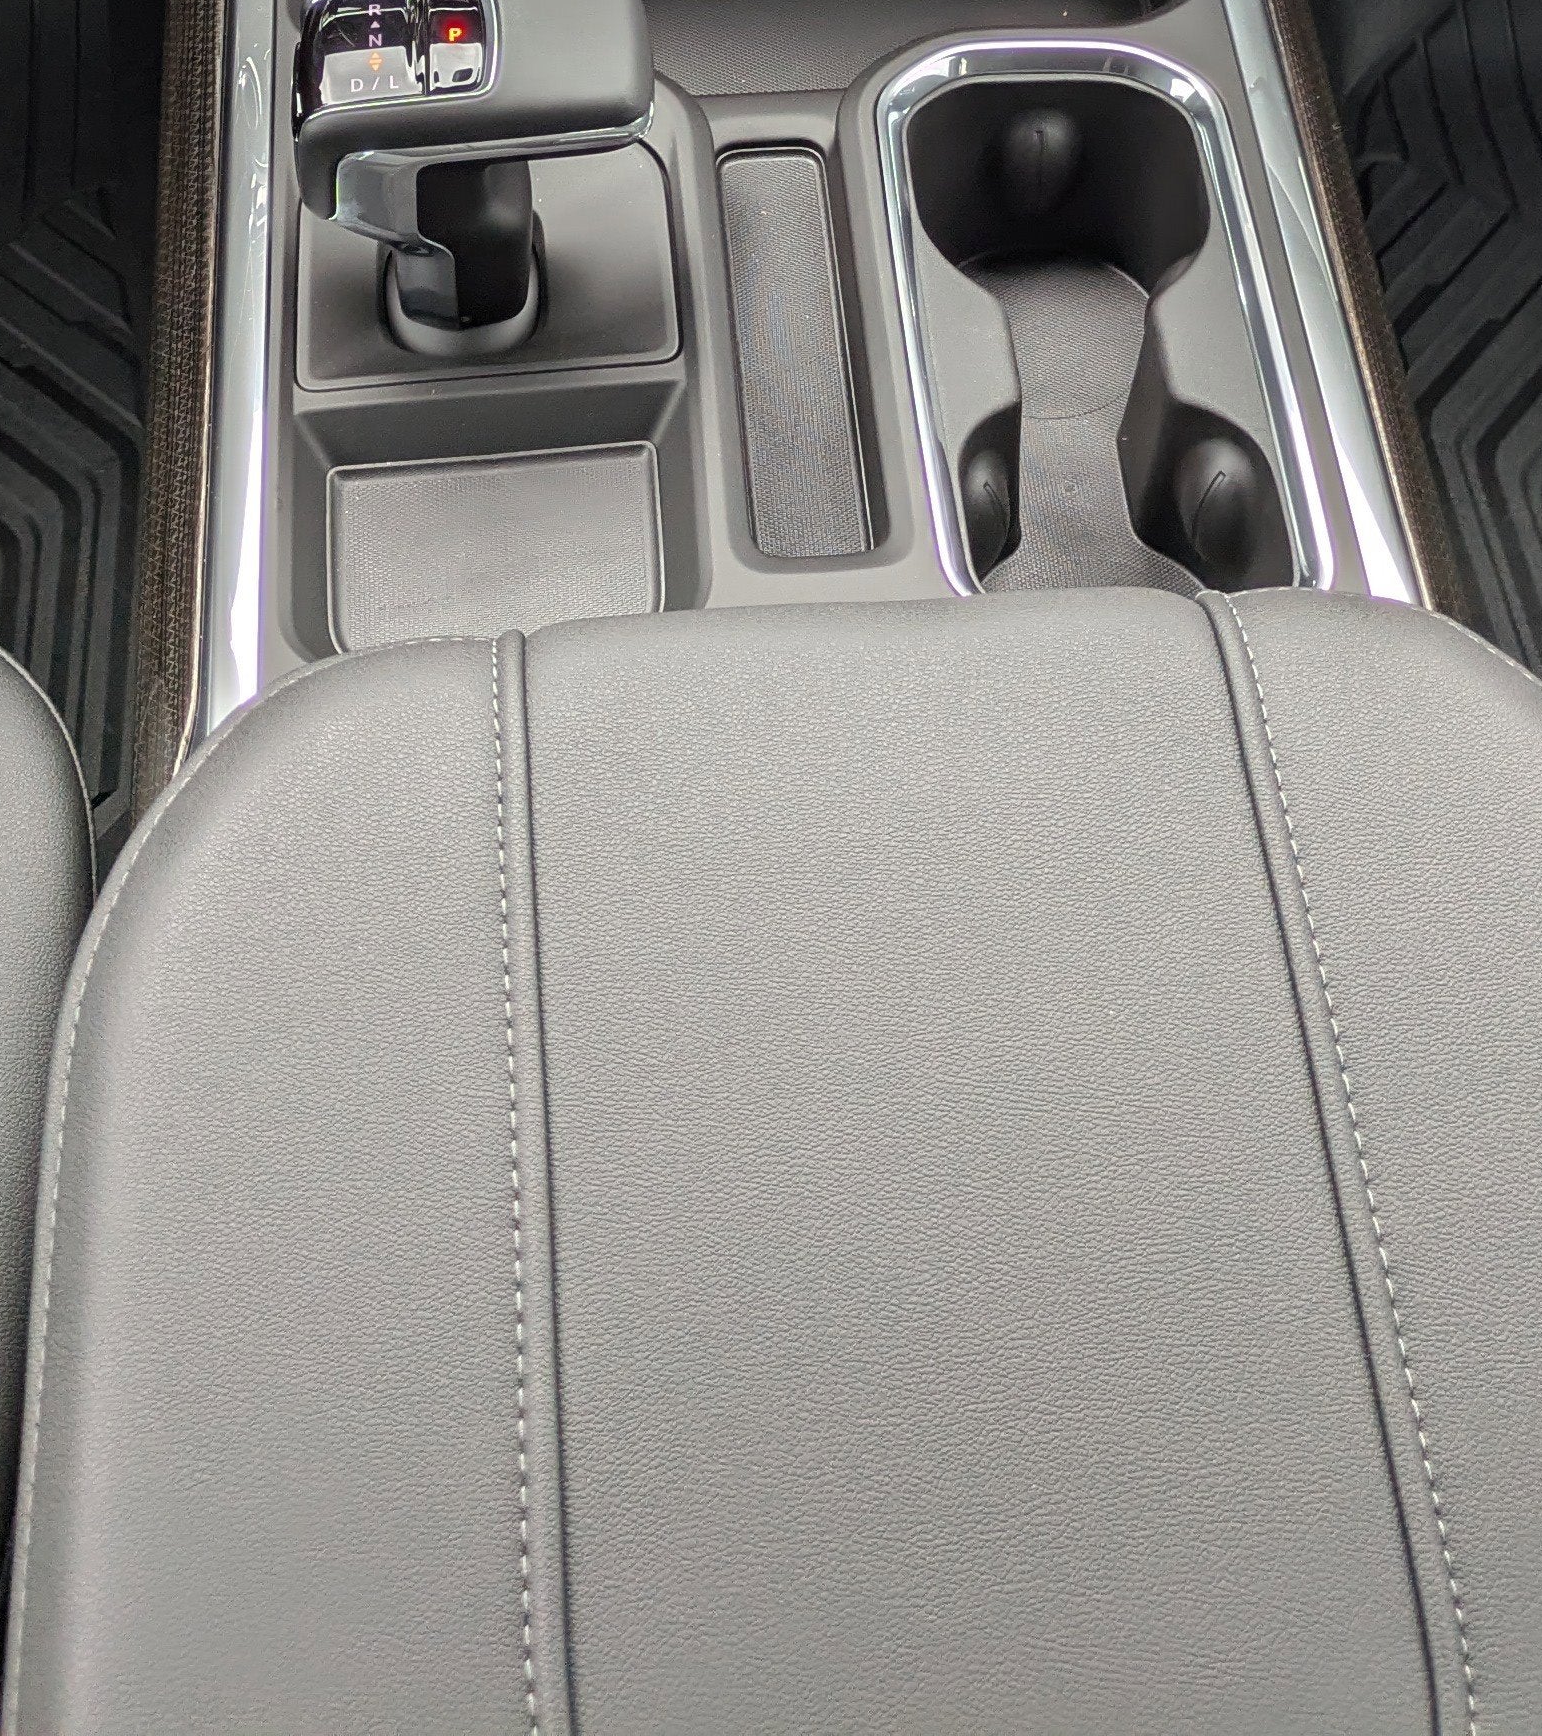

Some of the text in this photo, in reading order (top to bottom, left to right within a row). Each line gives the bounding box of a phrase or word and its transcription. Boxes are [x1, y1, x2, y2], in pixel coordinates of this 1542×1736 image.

[368, 4, 381, 16] R
[368, 34, 382, 47] N
[448, 27, 463, 42] P
[350, 79, 364, 93] D
[389, 76, 400, 89] L
